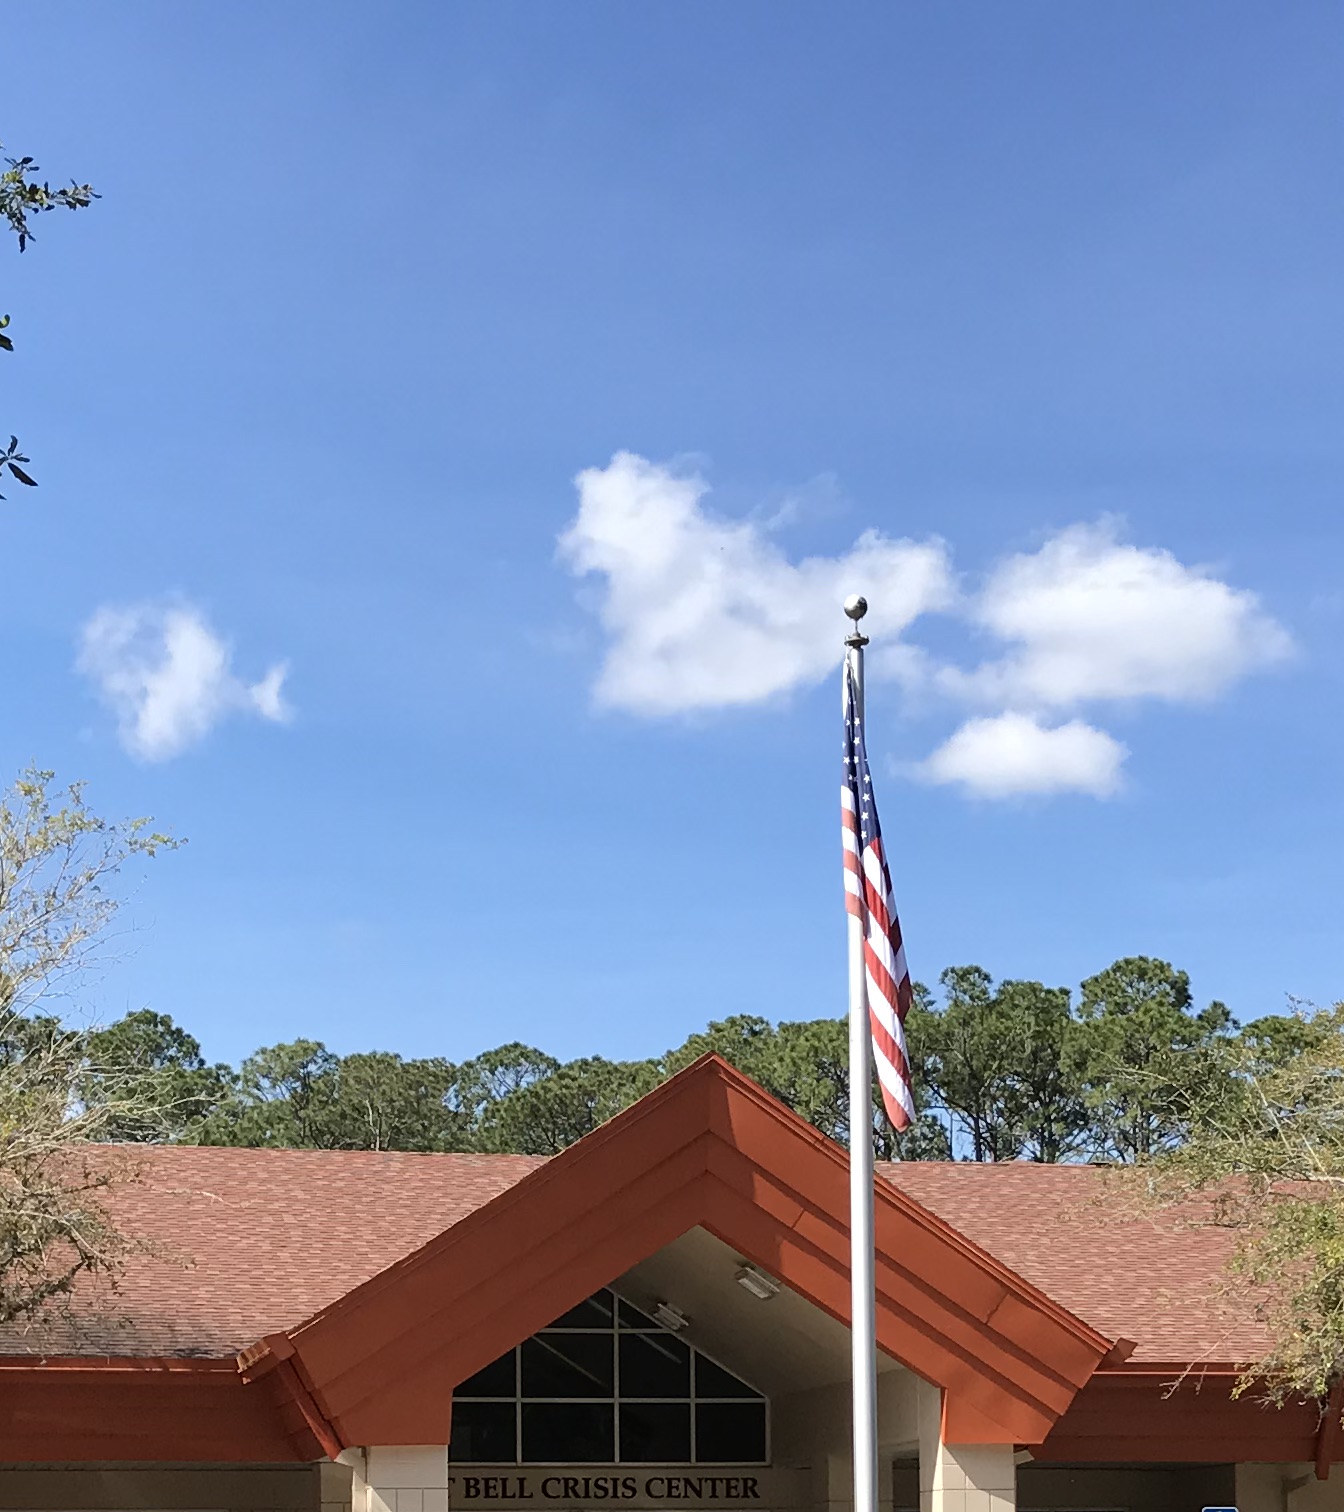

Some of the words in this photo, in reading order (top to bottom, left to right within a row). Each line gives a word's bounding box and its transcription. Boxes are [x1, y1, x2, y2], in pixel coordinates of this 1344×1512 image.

[462, 1476, 534, 1499] BELL
[540, 1476, 638, 1500] CRISIS
[644, 1476, 761, 1500] CENTER
